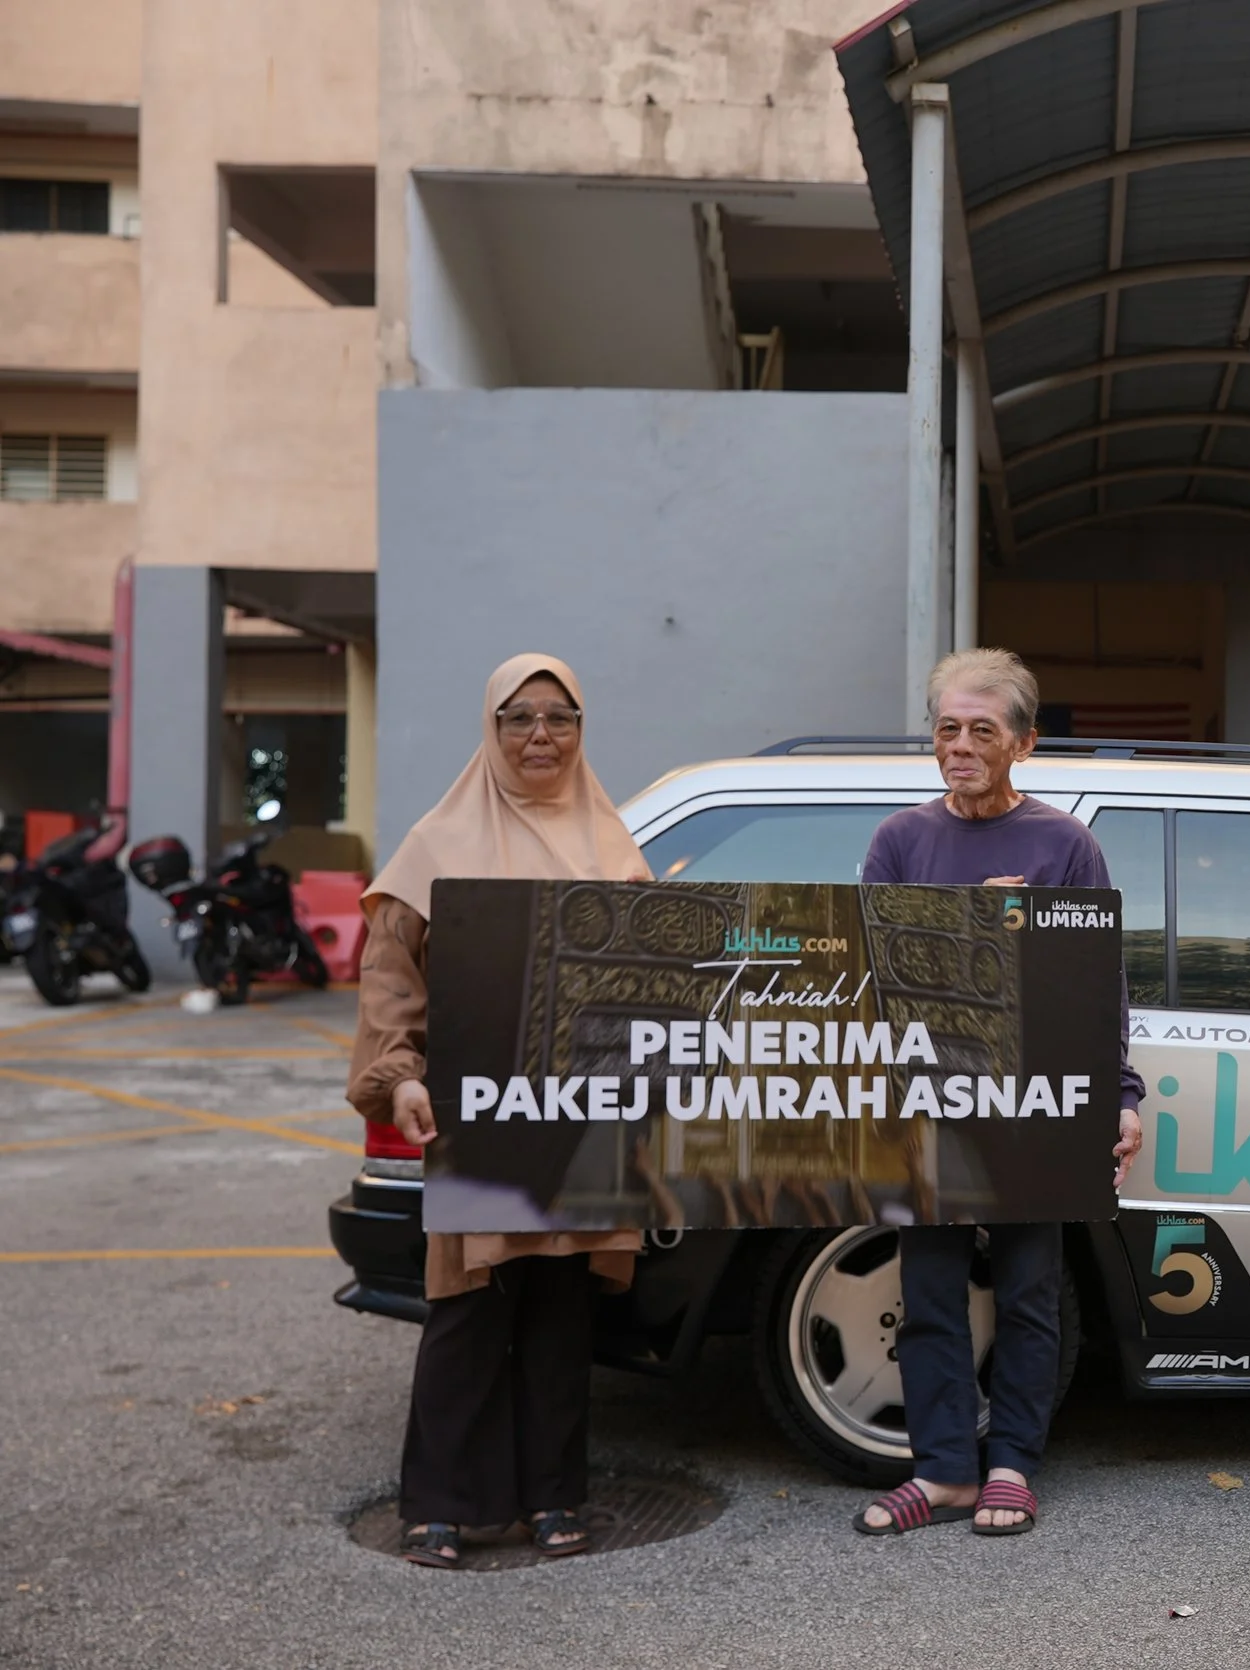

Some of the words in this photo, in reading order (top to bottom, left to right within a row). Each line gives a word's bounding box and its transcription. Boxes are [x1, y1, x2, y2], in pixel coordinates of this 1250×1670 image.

[1036, 911, 1114, 929] UMRAH
[693, 957, 872, 1021] Tahniah!
[630, 1020, 939, 1065] PENERIMA
[460, 1075, 649, 1122] PAKEJ
[665, 1075, 887, 1121] UMRAH
[899, 1075, 1091, 1119] ASNAF
[1149, 1225, 1214, 1315] 5
[1201, 1252, 1222, 1307] ANNIVERSARY
